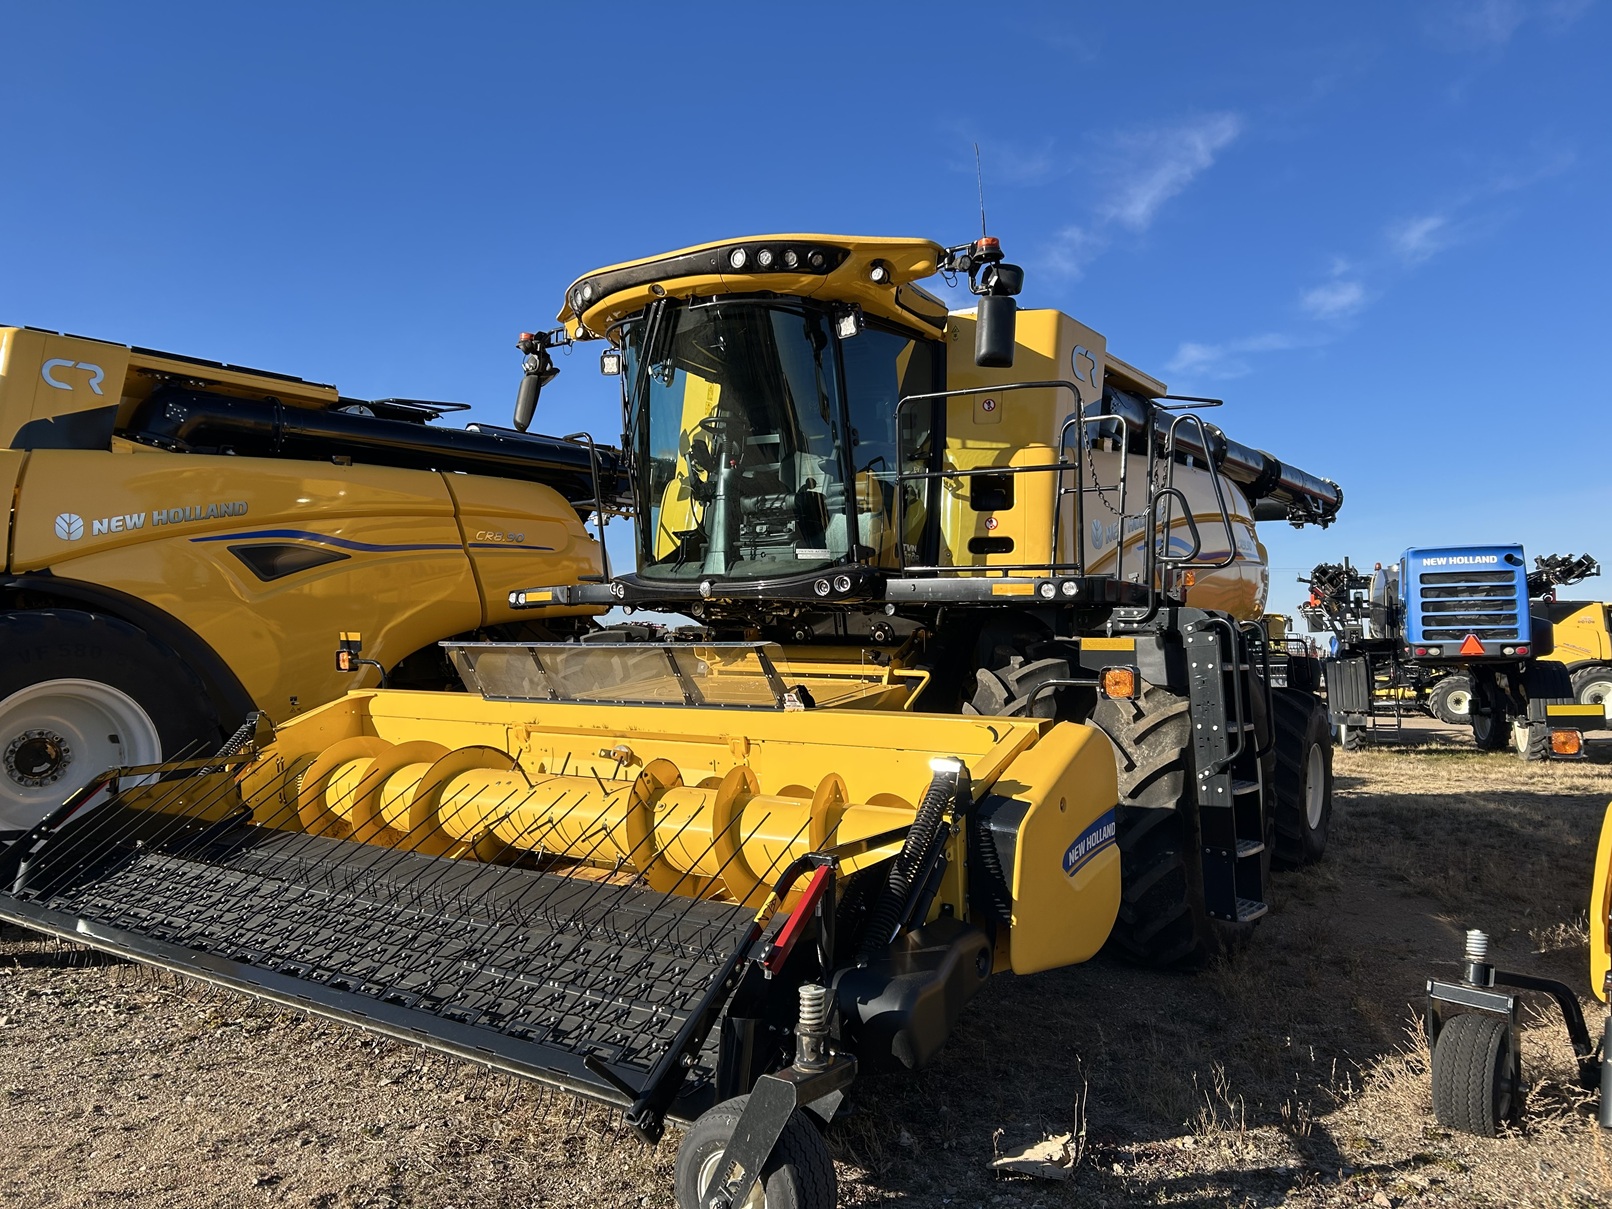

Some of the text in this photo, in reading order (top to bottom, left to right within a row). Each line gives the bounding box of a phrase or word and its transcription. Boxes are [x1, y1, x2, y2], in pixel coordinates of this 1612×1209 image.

[41, 357, 105, 396] CR
[1071, 344, 1098, 389] CR
[92, 500, 249, 536] NEW HOLLAND
[475, 530, 525, 543] CR8.90
[1422, 555, 1498, 566] NEW HOLLAND
[1068, 821, 1116, 866] NEW HOLLAND
